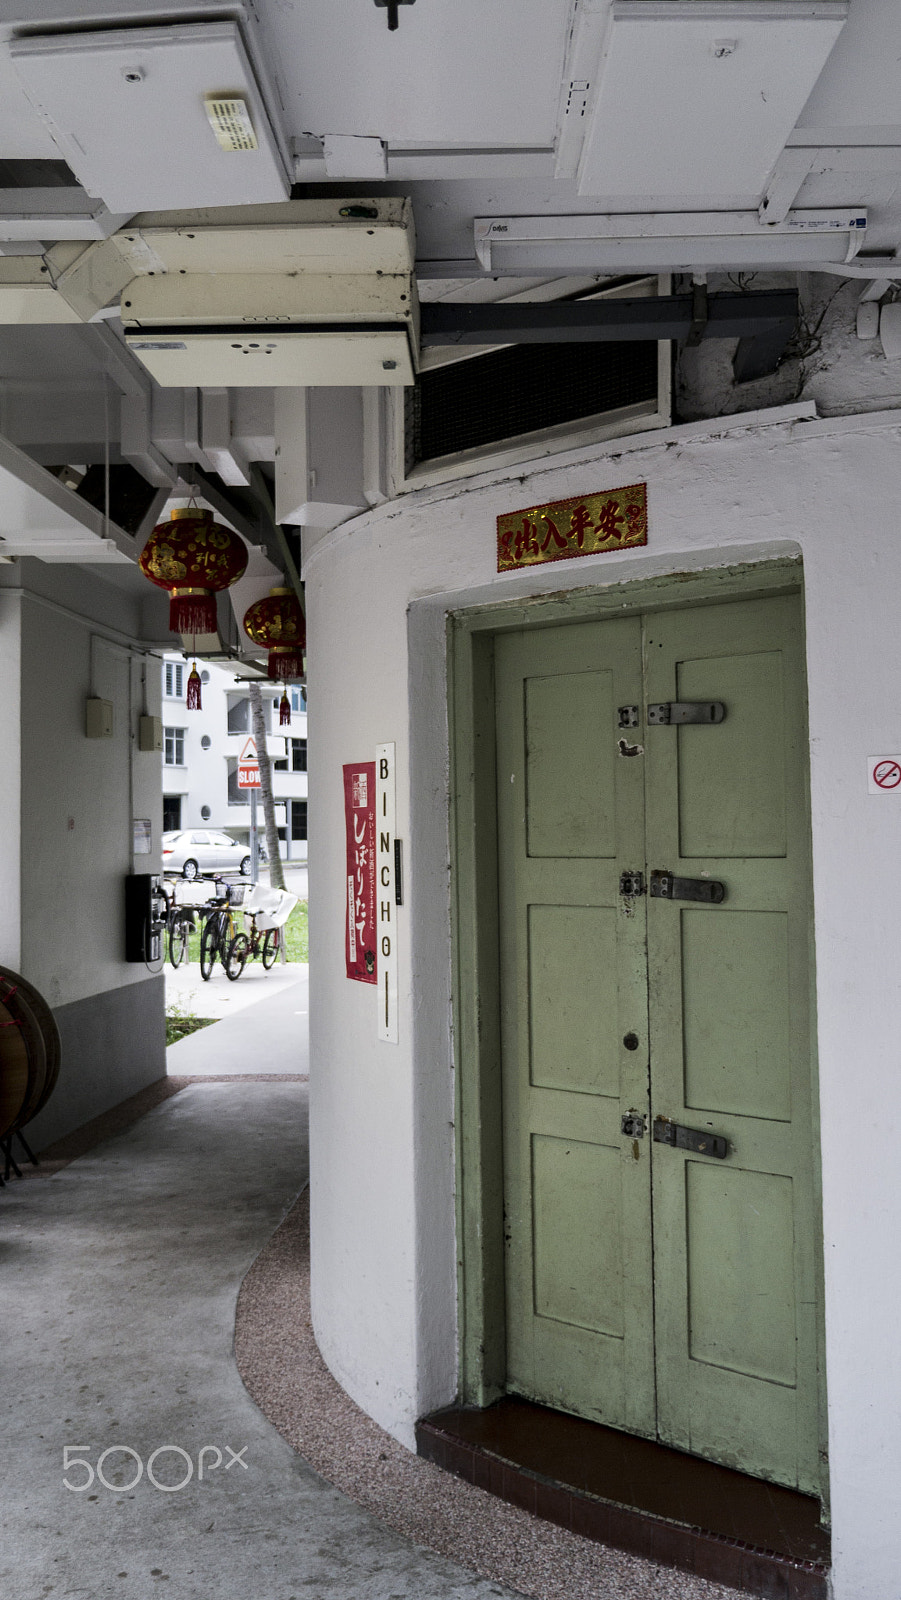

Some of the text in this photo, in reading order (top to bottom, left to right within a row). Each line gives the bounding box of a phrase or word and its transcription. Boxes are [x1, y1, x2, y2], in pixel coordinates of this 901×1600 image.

[514, 500, 625, 560] 出入平安
[354, 813, 369, 946] しぼりたて
[380, 758, 390, 957] BINCHO
